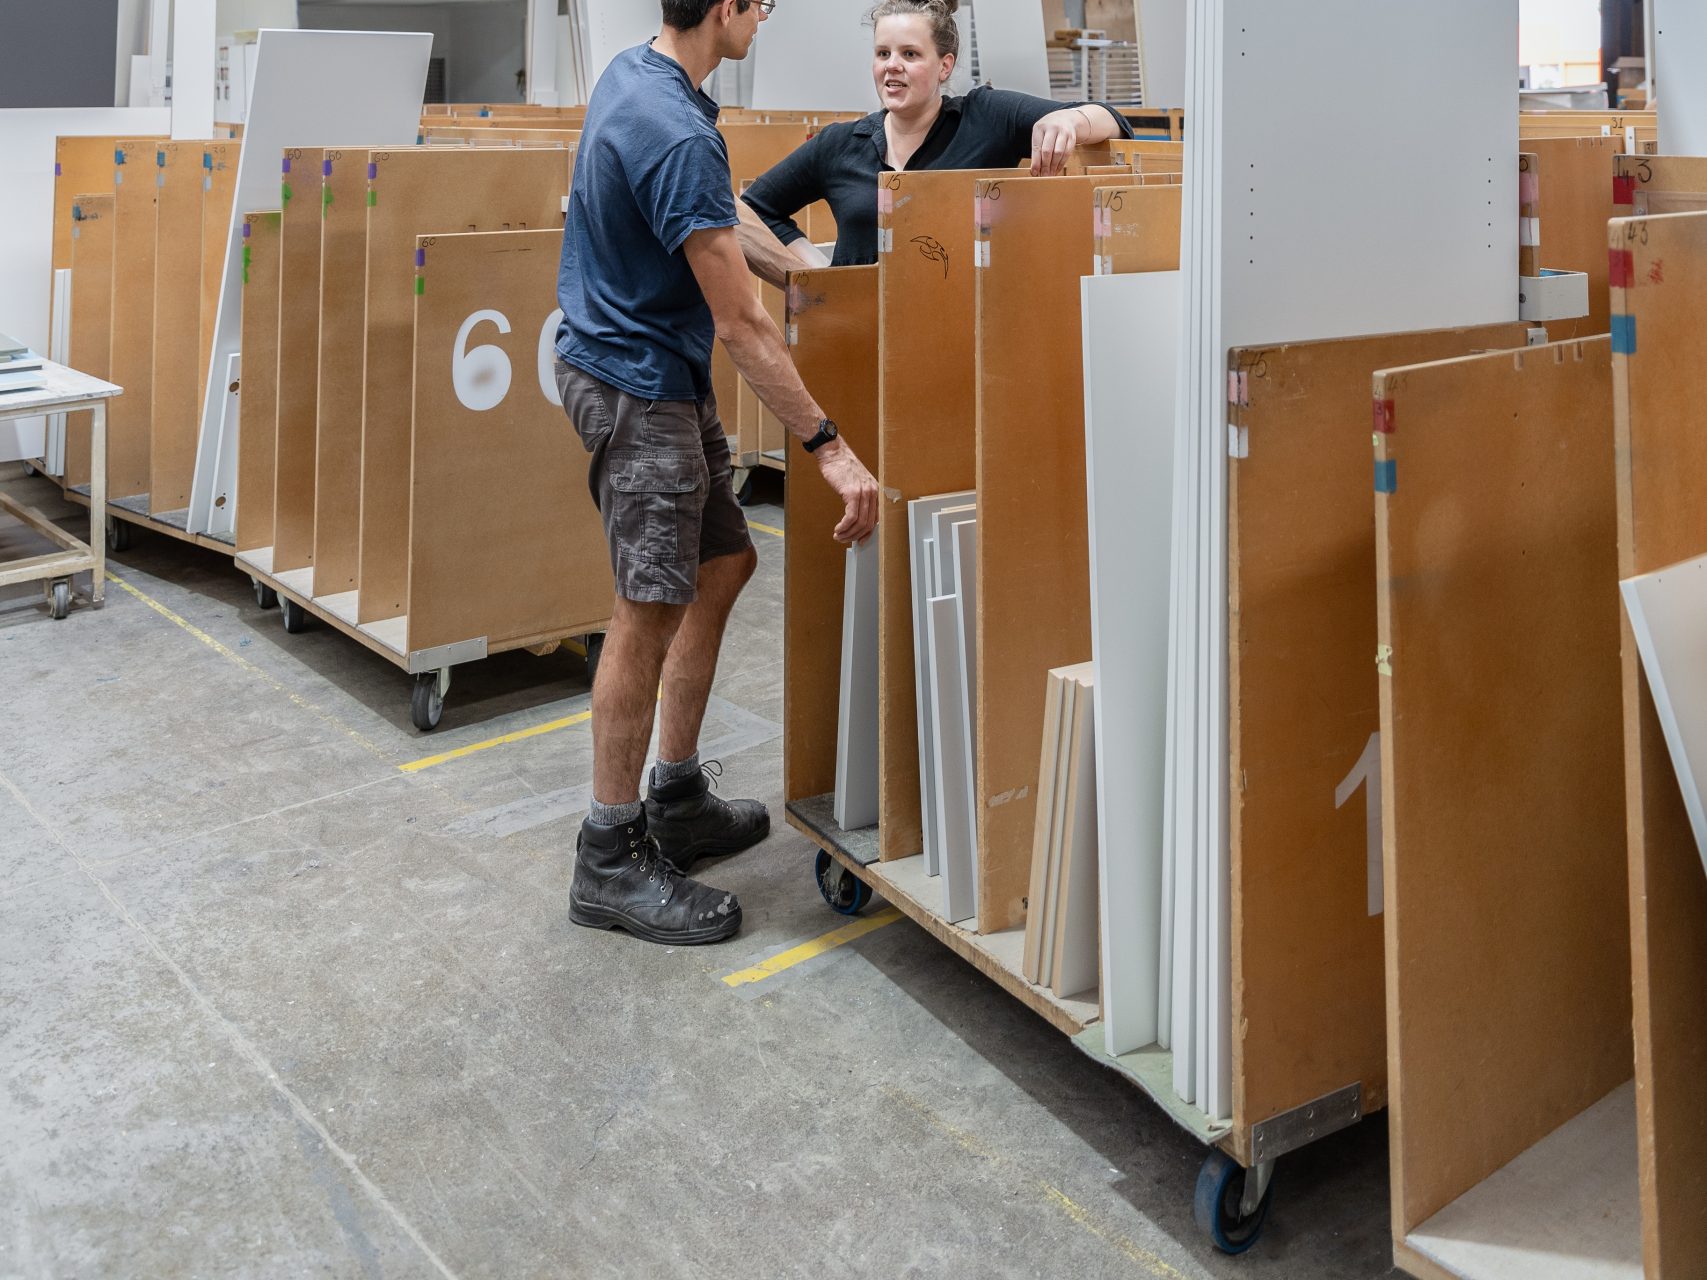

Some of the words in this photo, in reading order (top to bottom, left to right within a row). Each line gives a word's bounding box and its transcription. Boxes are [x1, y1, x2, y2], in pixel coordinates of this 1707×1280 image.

[287, 149, 302, 160] 60
[328, 151, 342, 161] 60
[885, 174, 906, 191] 15
[984, 181, 1004, 200] 15
[1105, 190, 1128, 212] 15
[421, 236, 436, 248] 60
